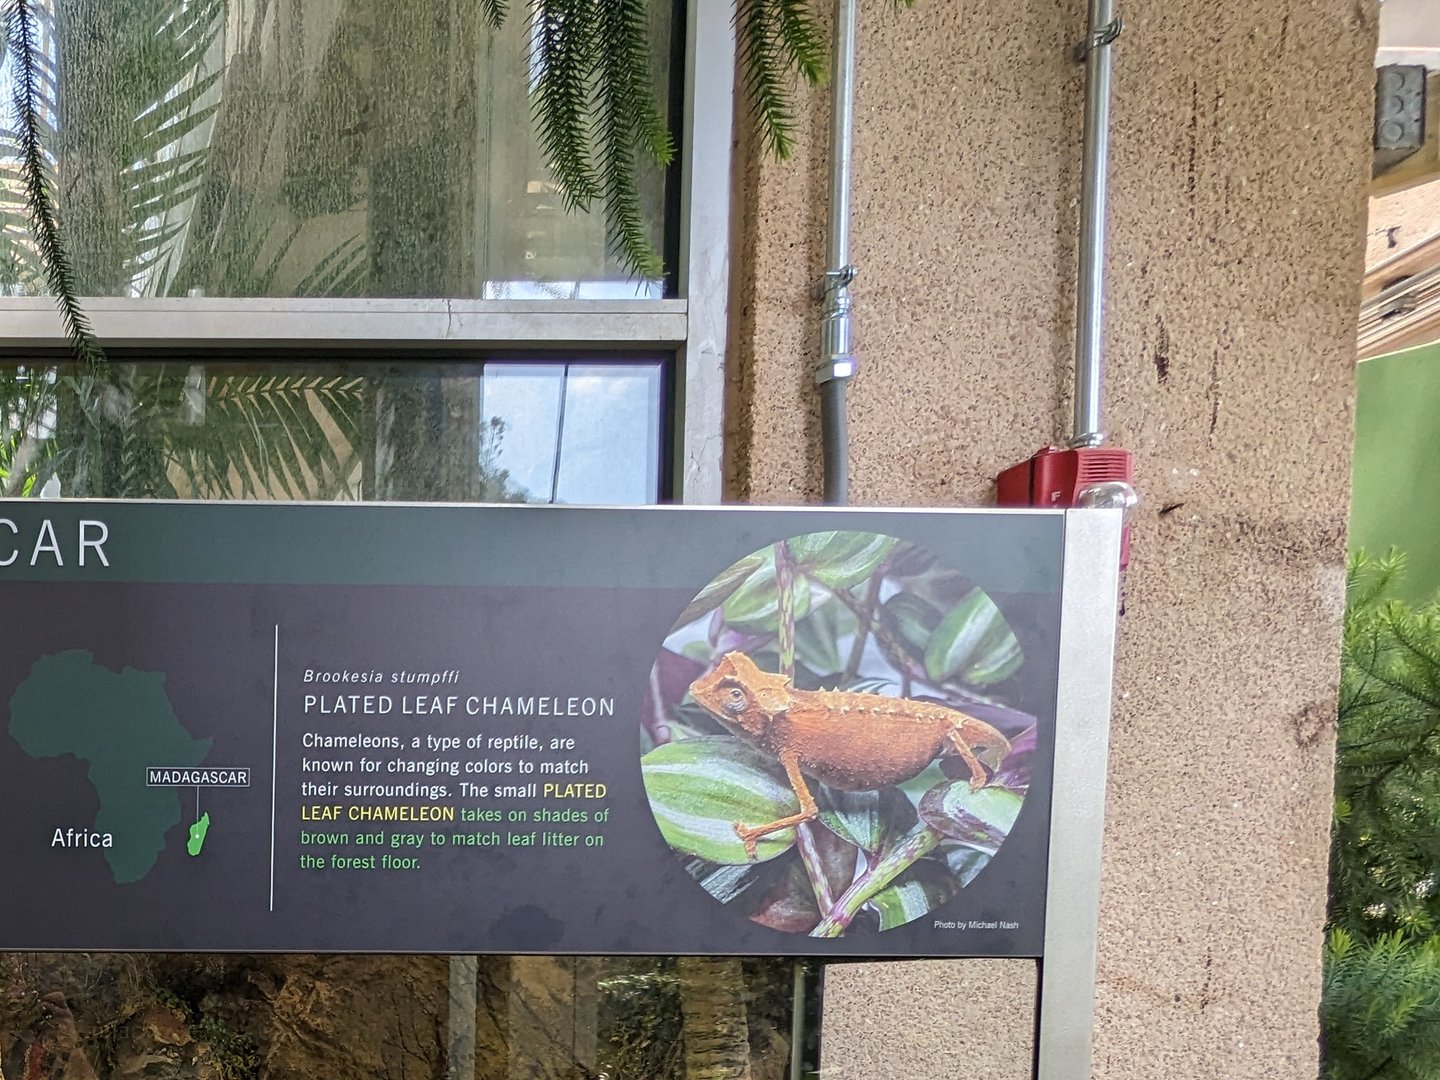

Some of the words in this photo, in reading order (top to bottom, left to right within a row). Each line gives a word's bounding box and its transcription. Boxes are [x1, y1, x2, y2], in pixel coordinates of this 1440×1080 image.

[303, 669, 382, 683] Brookesia
[390, 669, 460, 686] stumpffi
[304, 695, 392, 713] PLATED
[402, 695, 458, 714] LEAF
[466, 696, 614, 716] CHAMELEON
[302, 732, 404, 750] Chameleons,
[411, 736, 420, 748] a
[426, 734, 460, 752] type
[466, 733, 482, 748] of
[488, 734, 543, 752] reptile,
[550, 737, 575, 749] are
[302, 757, 353, 772] known
[359, 757, 382, 772] for
[387, 757, 460, 776] changing
[465, 758, 512, 773] colors
[518, 759, 534, 773] to
[540, 758, 588, 774] match
[149, 769, 248, 785] MADAGASCAR
[301, 781, 338, 796] their
[344, 781, 452, 800] surroundings.
[458, 782, 488, 797] The
[494, 782, 536, 798] small
[544, 783, 606, 798] PLATED
[302, 805, 342, 820] LEAF
[348, 805, 454, 821] CHAMELEON
[460, 807, 502, 821] takes
[508, 810, 526, 821] on
[533, 807, 588, 822] shades
[594, 807, 609, 822] of
[51, 828, 112, 847] Africa
[301, 830, 348, 844] brown
[355, 830, 384, 844] and
[390, 833, 424, 848] gray
[430, 831, 445, 845] to
[452, 831, 500, 845] match
[507, 831, 536, 846] leaf
[542, 831, 580, 846] litter
[584, 835, 603, 846] on
[934, 920, 956, 929] Photo
[956, 921, 966, 930] by
[968, 920, 998, 929] Michael
[998, 920, 1019, 929] Nash
